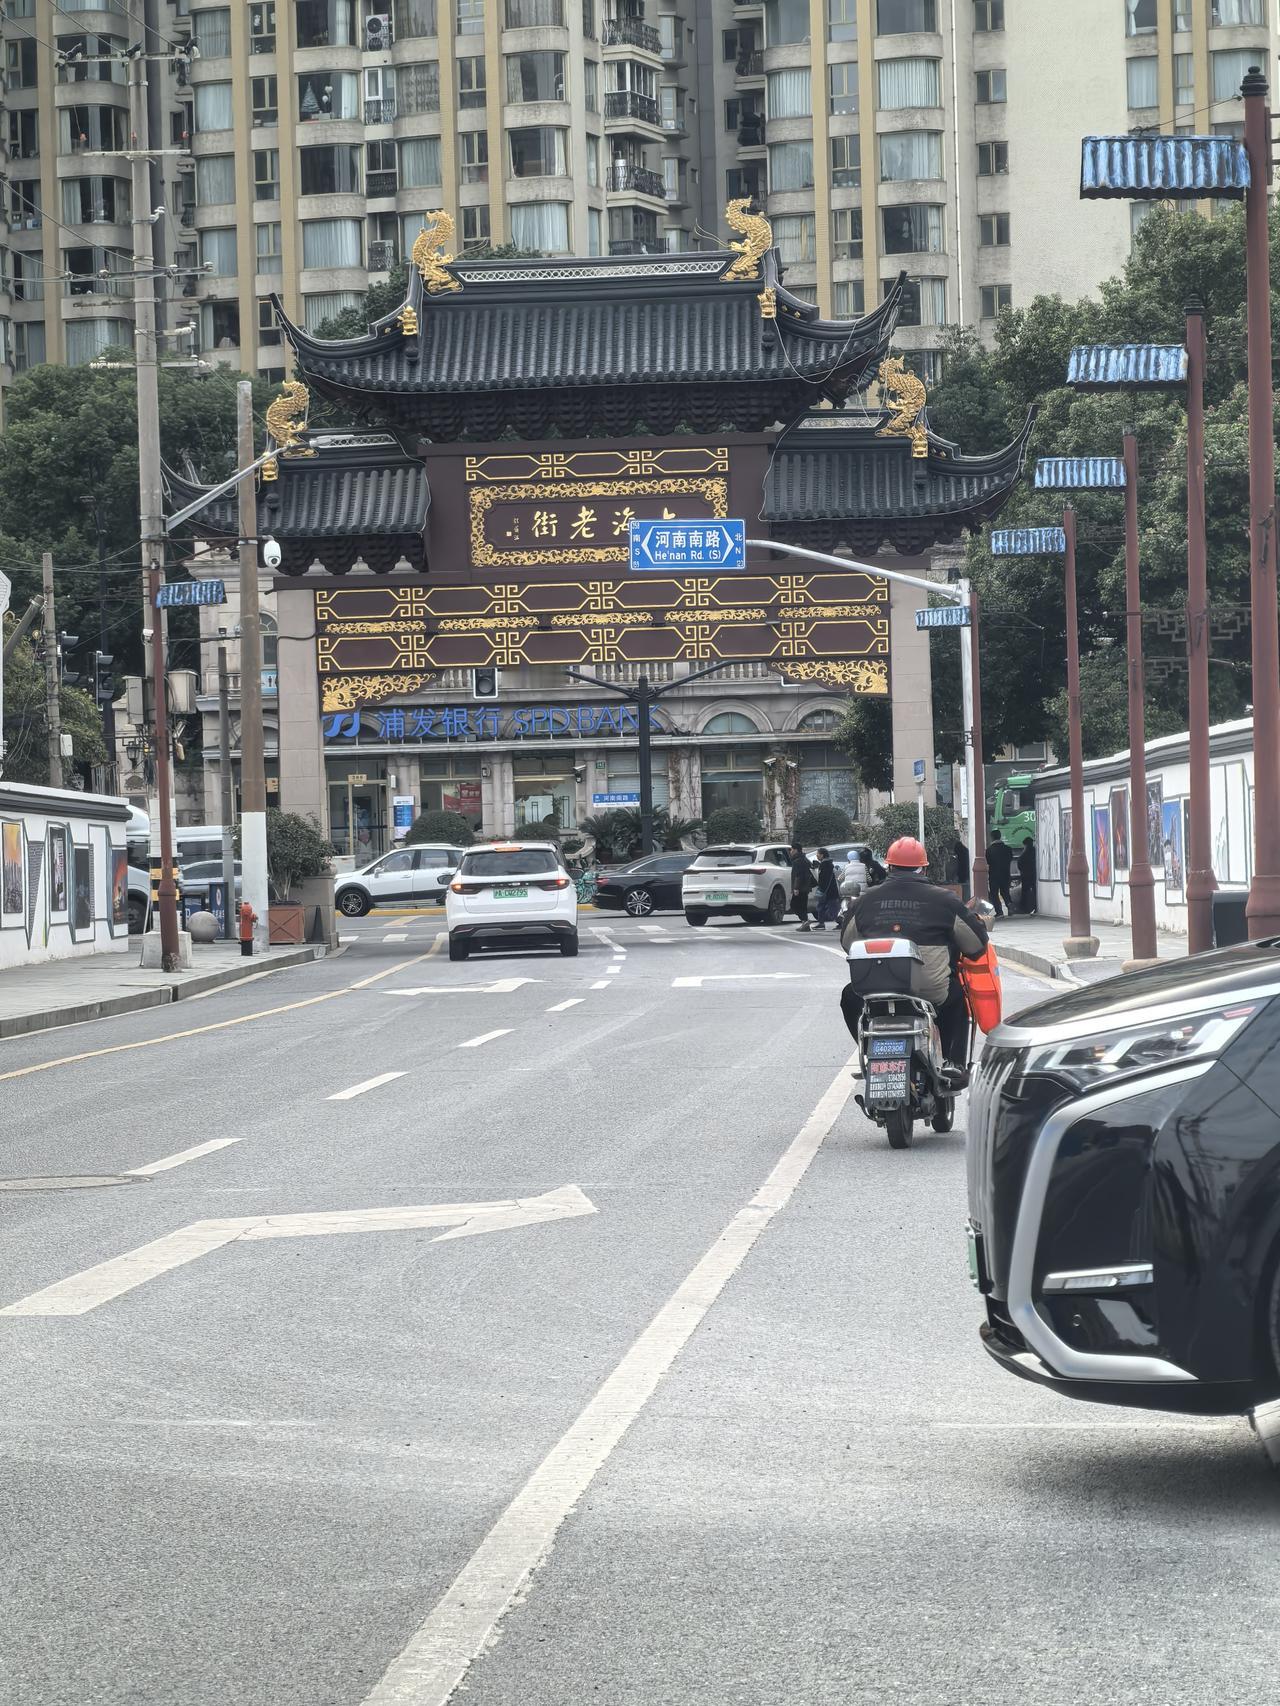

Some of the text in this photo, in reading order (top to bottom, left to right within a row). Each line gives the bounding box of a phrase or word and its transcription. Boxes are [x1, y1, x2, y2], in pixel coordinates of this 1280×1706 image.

[655, 530, 720, 548] 河南南路
[735, 533, 742, 541] 北
[635, 548, 640, 556] S
[655, 549, 721, 560] He'nan Rd. (S)
[735, 547, 741, 555] N
[378, 707, 501, 737] 浦发银行
[514, 707, 570, 734] SPD
[880, 900, 921, 909] HEROIC
